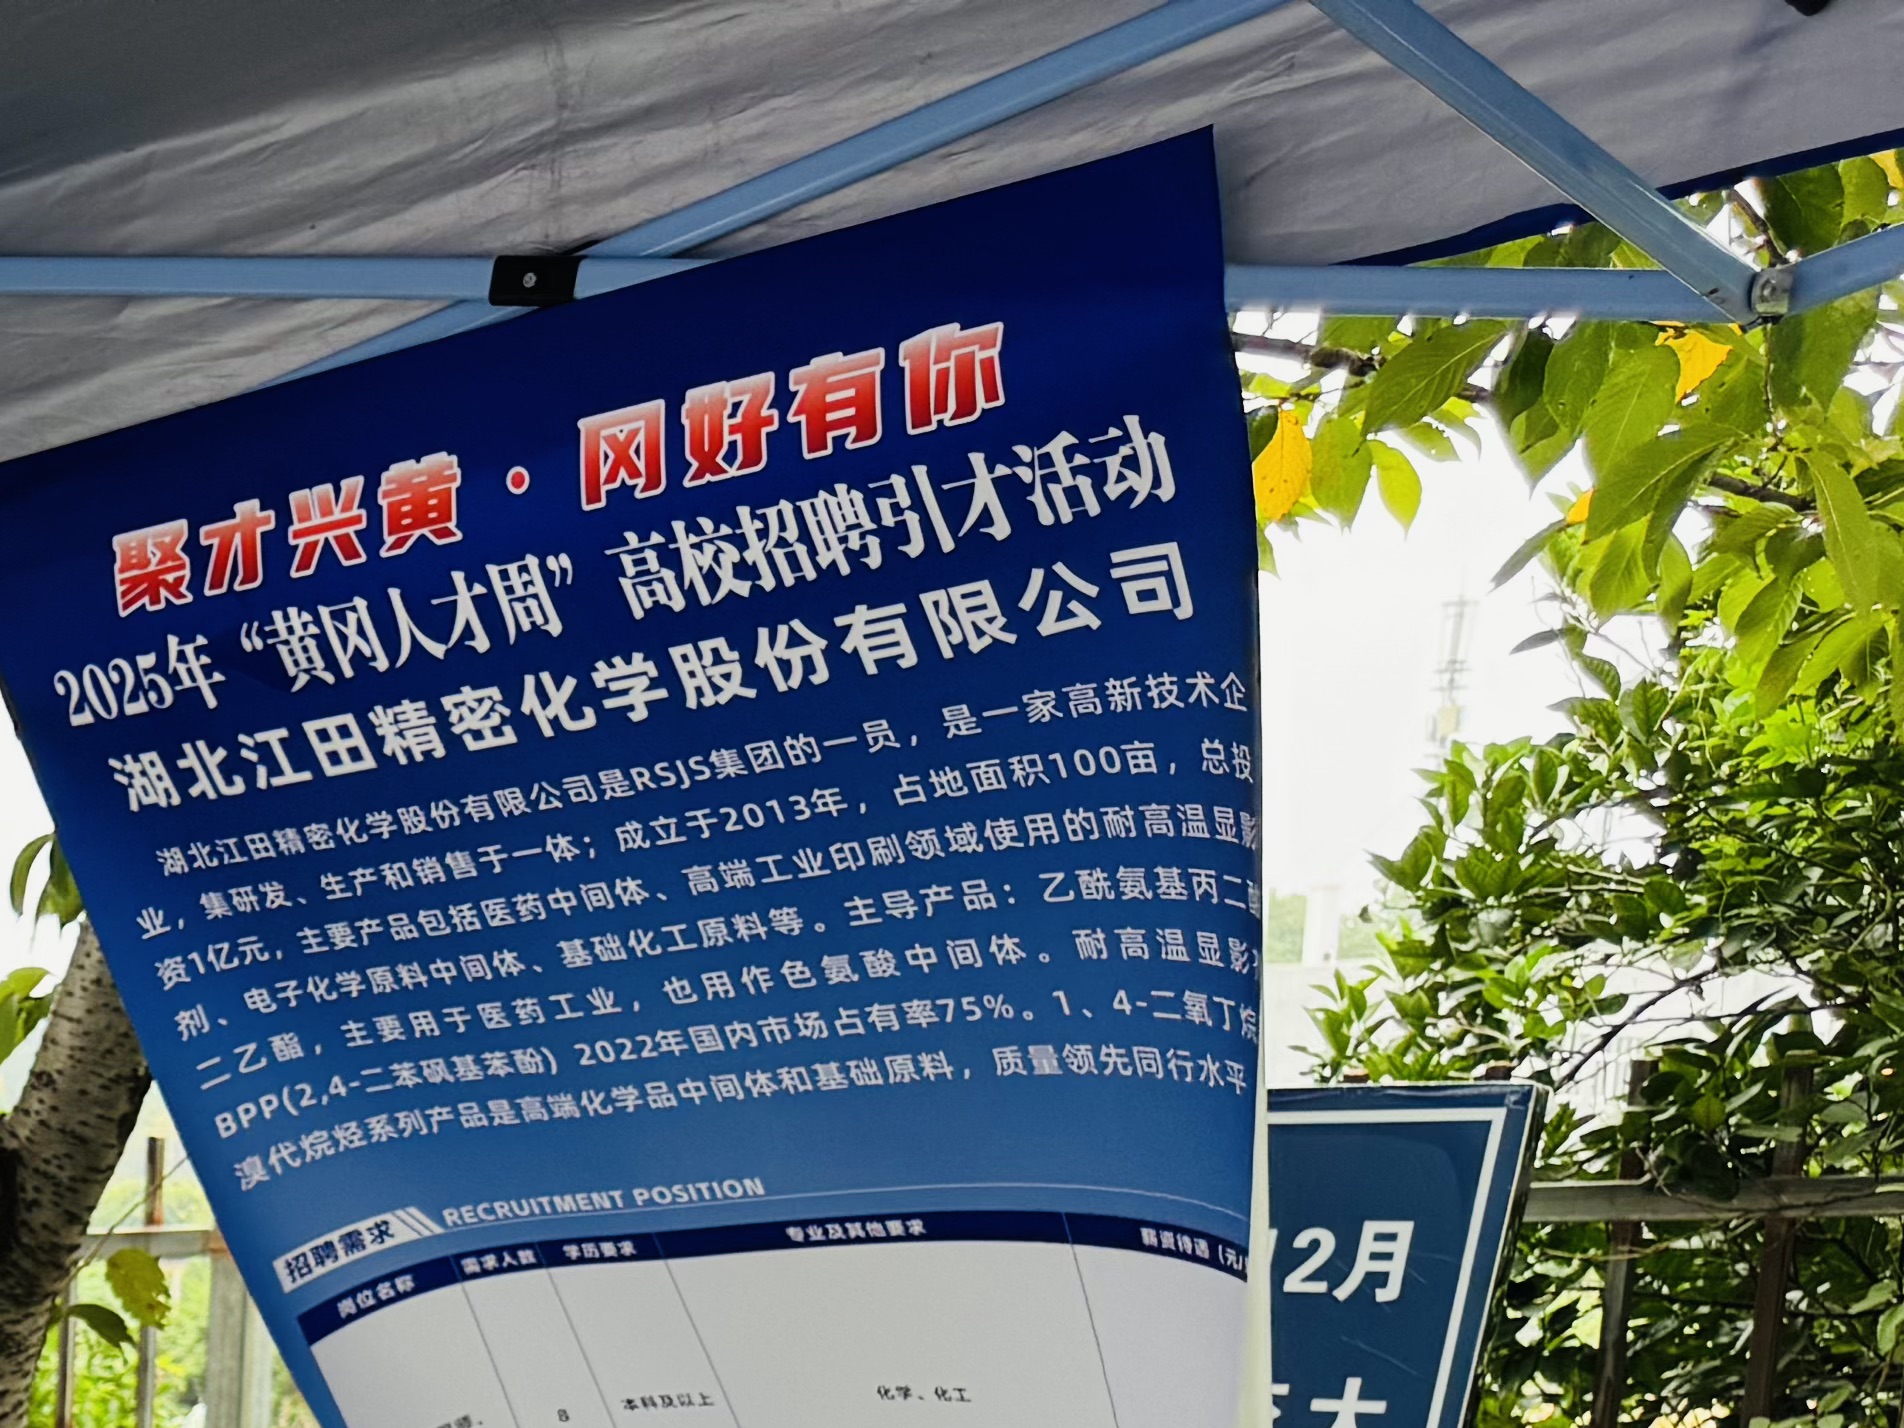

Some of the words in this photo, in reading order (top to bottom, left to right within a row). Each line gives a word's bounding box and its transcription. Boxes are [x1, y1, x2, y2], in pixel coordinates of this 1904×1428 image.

[111, 321, 1005, 617] 聚才兴黄·冈好有你
[108, 541, 1194, 812] 湖北江田精密化学股份有限公司
[156, 670, 1248, 876] 湖北江田精密化学股份有限公司是RSJS集团的一员，是一家高新技术企
[196, 927, 1259, 1091] 二乙酯，主要用于医药工业，也用作色氨酸中间体。耐高温显影
[442, 1191, 623, 1228] RECRUITMENT
[636, 1178, 766, 1207] POSITION
[283, 1219, 395, 1284] 招聘需求
[461, 1248, 537, 1275] 需求人数
[562, 1240, 637, 1260] 学历要求
[1270, 1219, 1415, 1304] 2月
[337, 1275, 416, 1318] 岗位名称
